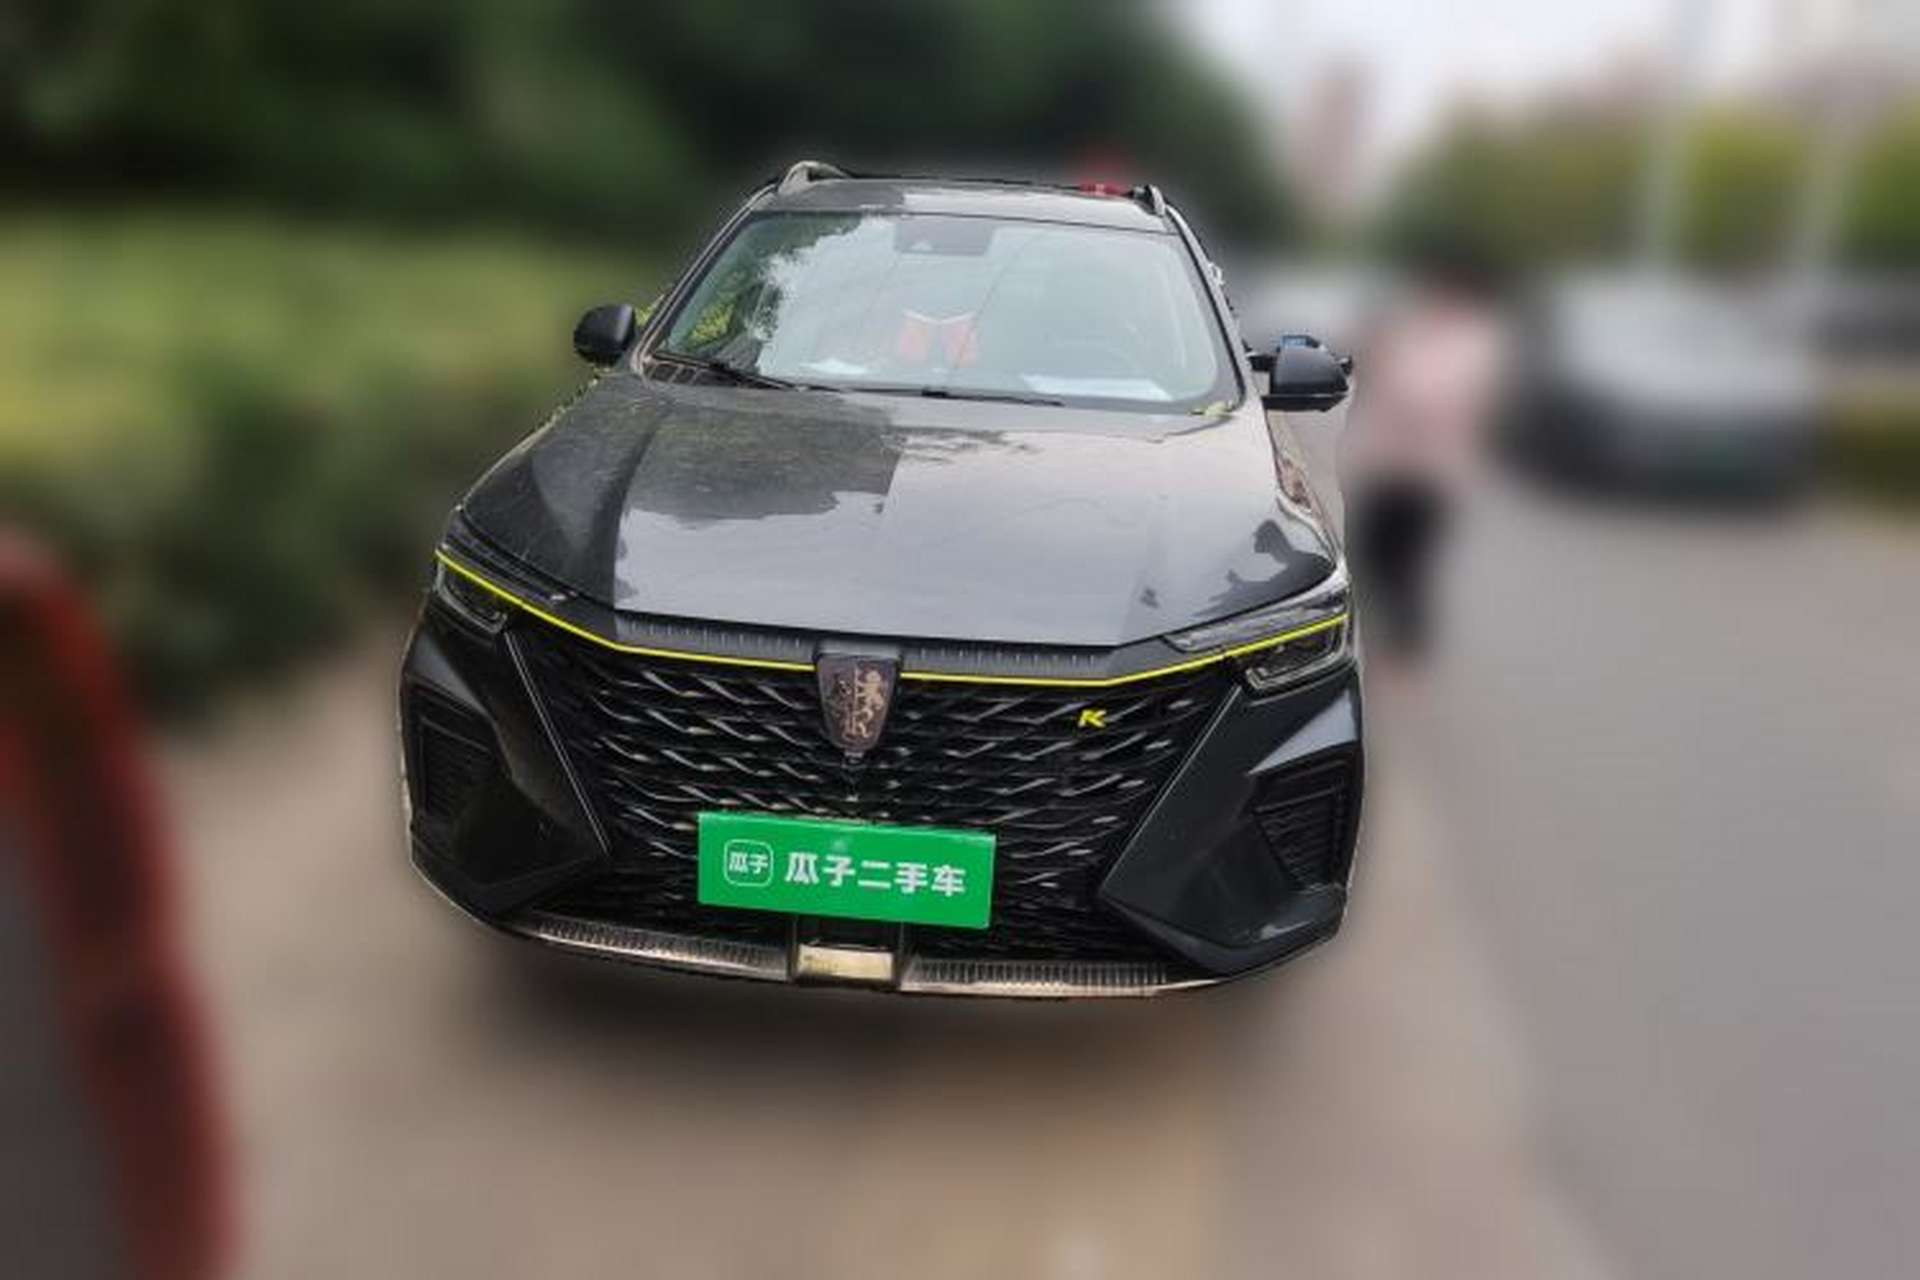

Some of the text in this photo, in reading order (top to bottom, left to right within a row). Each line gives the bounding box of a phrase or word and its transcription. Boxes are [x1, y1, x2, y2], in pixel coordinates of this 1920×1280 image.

[728, 851, 967, 897] 瓜子 瓜子二手车
